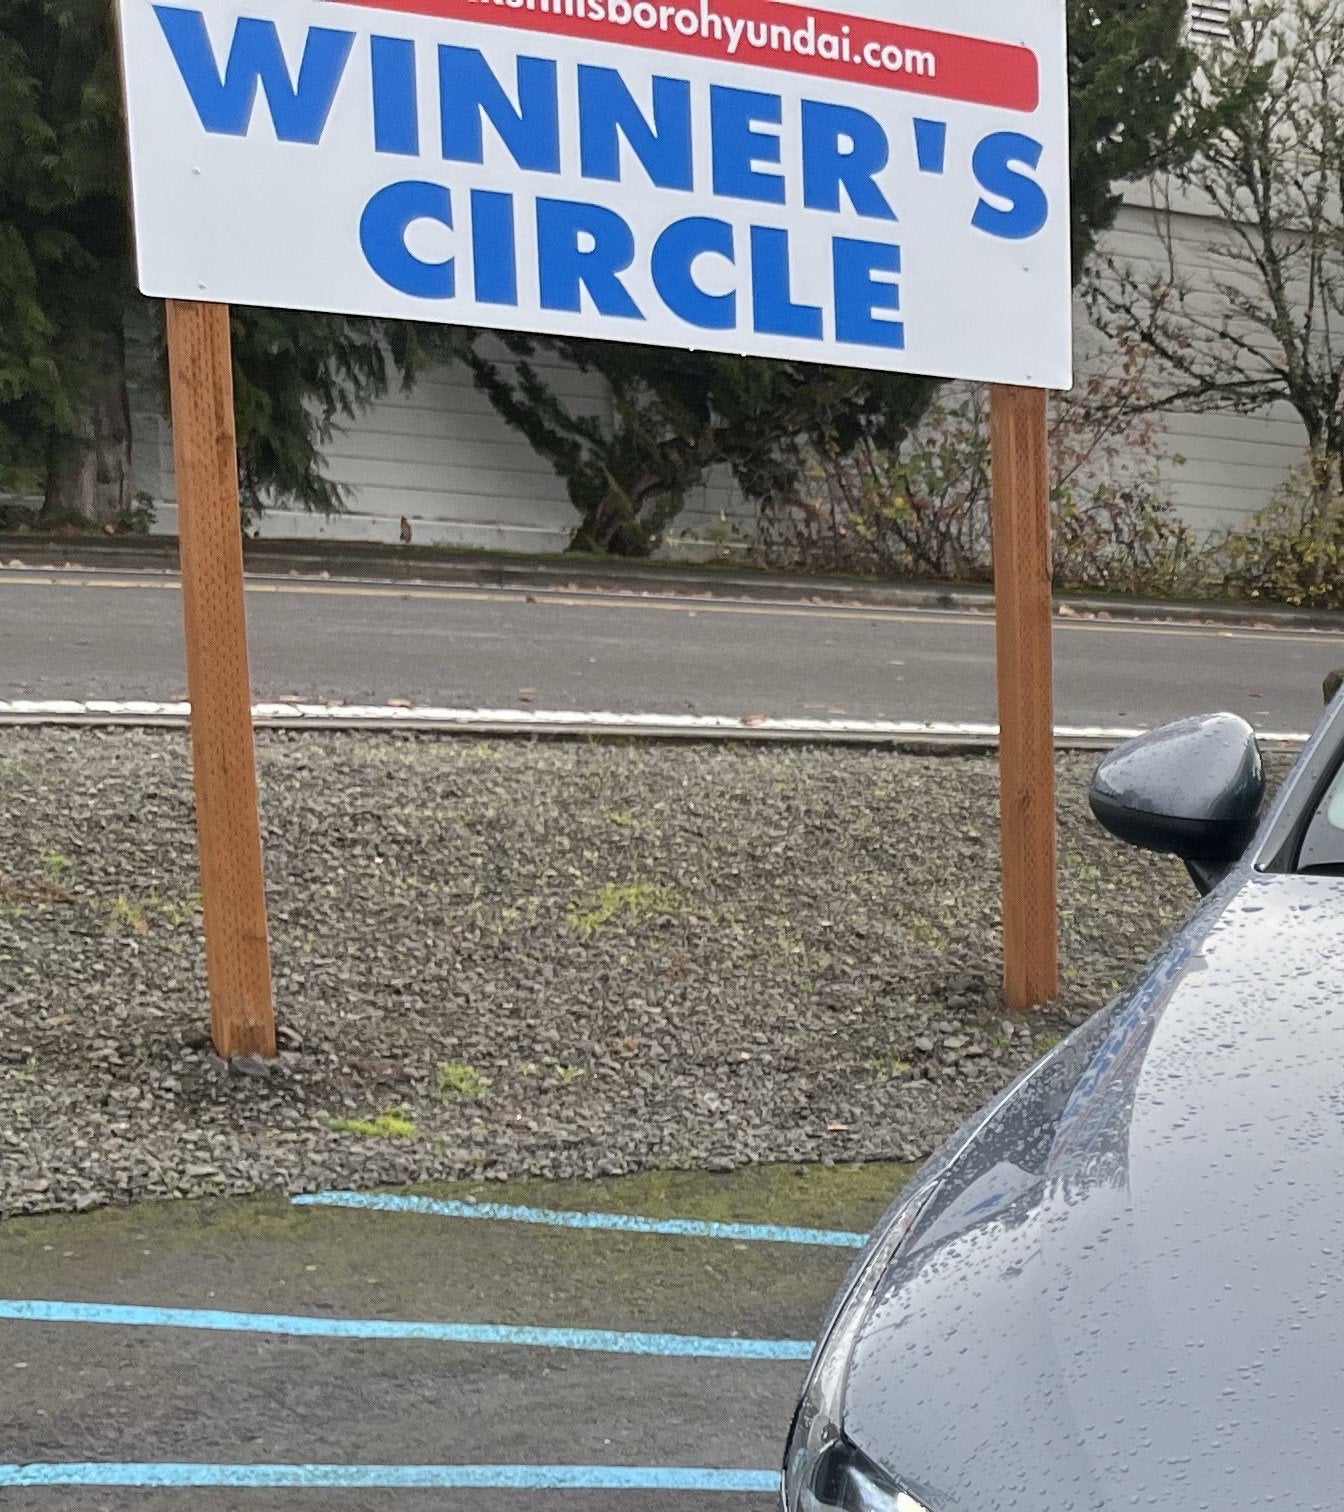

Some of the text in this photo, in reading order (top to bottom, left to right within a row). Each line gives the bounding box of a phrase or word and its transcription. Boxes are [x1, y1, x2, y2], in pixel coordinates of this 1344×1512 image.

[156, 4, 1049, 241] WINNER'S
[466, 0, 936, 77] sborohyundai.com
[360, 180, 905, 350] CIRCLE
